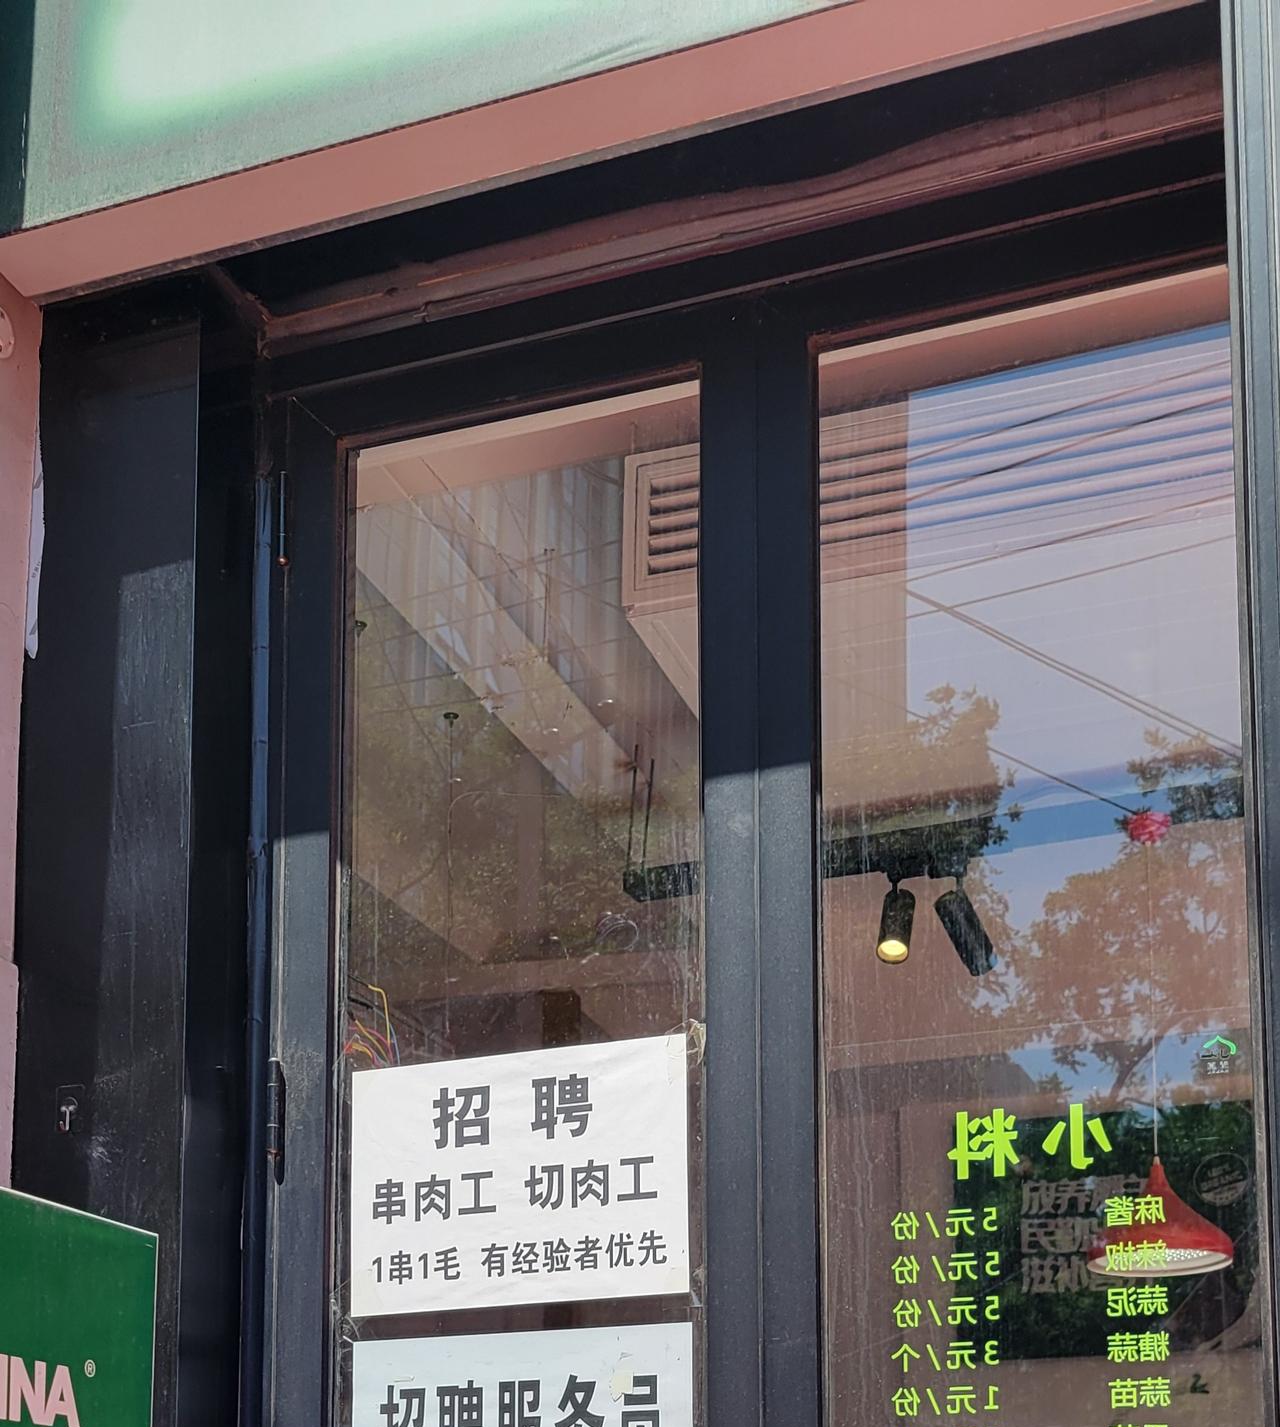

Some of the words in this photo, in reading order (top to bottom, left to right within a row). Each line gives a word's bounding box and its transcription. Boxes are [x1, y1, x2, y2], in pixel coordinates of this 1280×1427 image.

[432, 1073, 593, 1149] 招聘
[372, 1170, 497, 1225] 串肉工
[524, 1155, 658, 1210] 切肉工
[372, 1246, 461, 1285] 1串1毛
[480, 1230, 668, 1278] 有经验者优先
